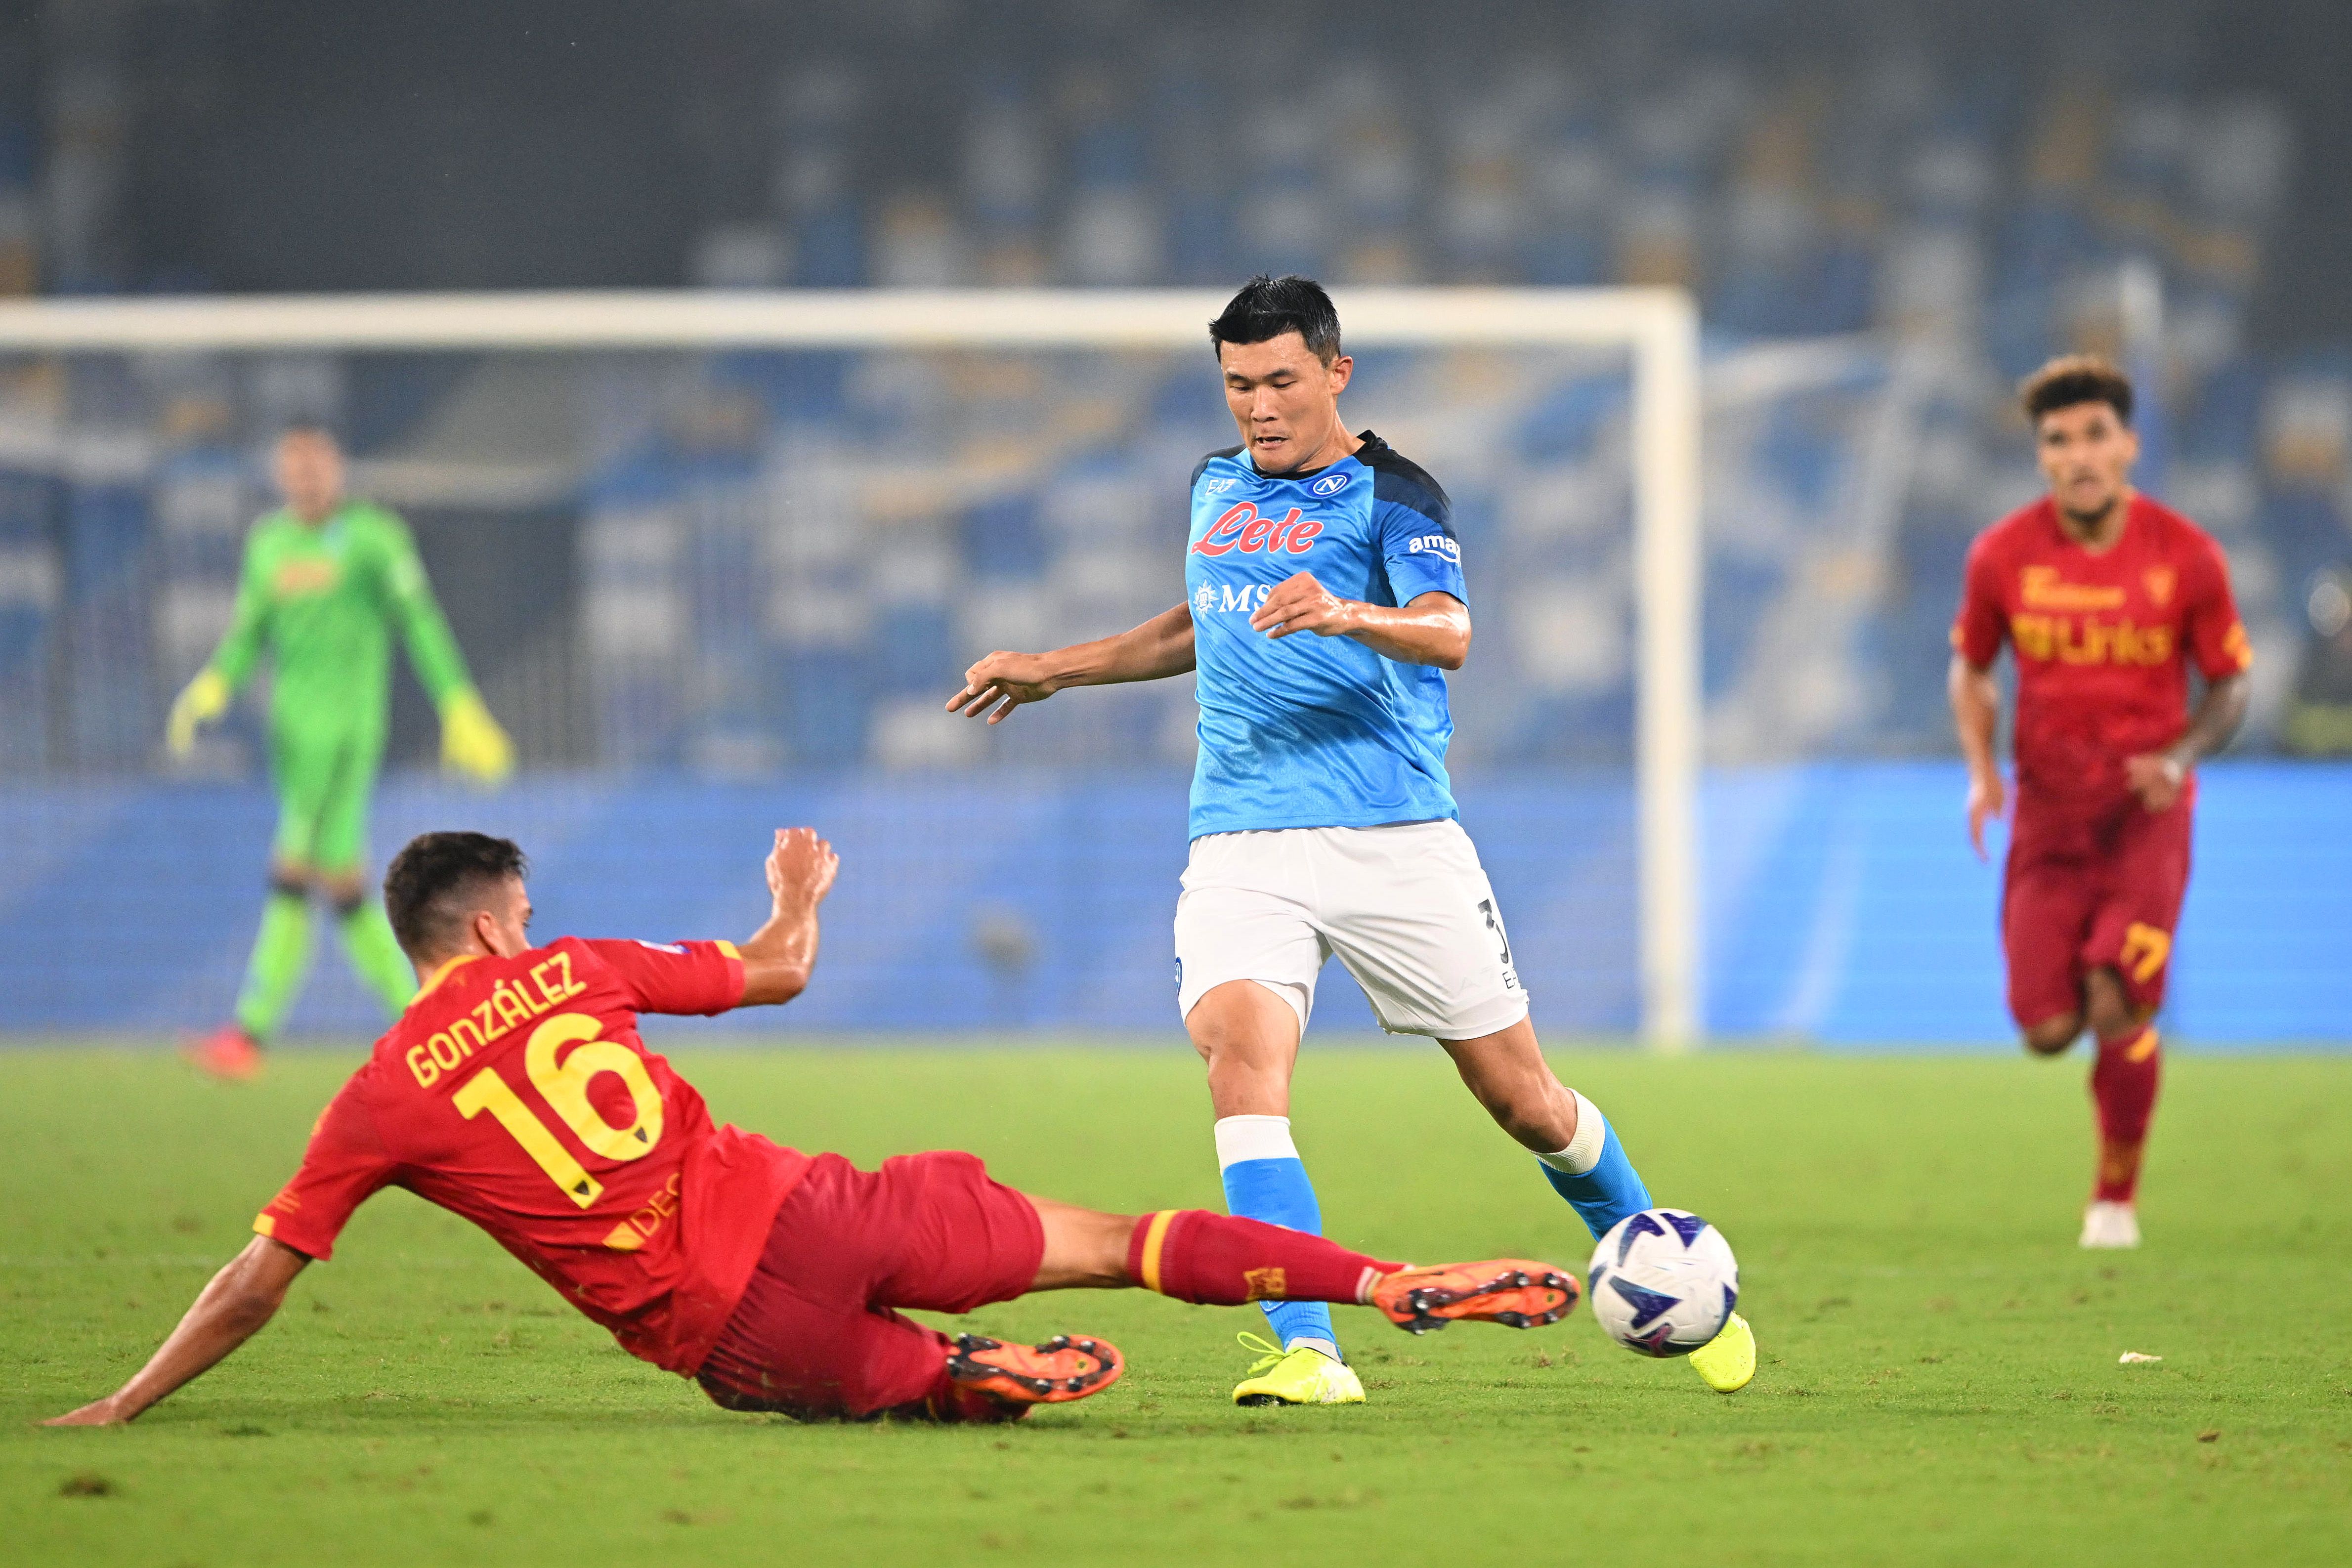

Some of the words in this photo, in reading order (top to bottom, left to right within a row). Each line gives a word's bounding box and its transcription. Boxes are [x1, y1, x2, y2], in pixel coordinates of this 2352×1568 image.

[1191, 501, 1324, 557] Lete
[1318, 478, 1343, 492] N
[406, 951, 587, 1089] GONZÁLEZ
[452, 1013, 663, 1210] 16
